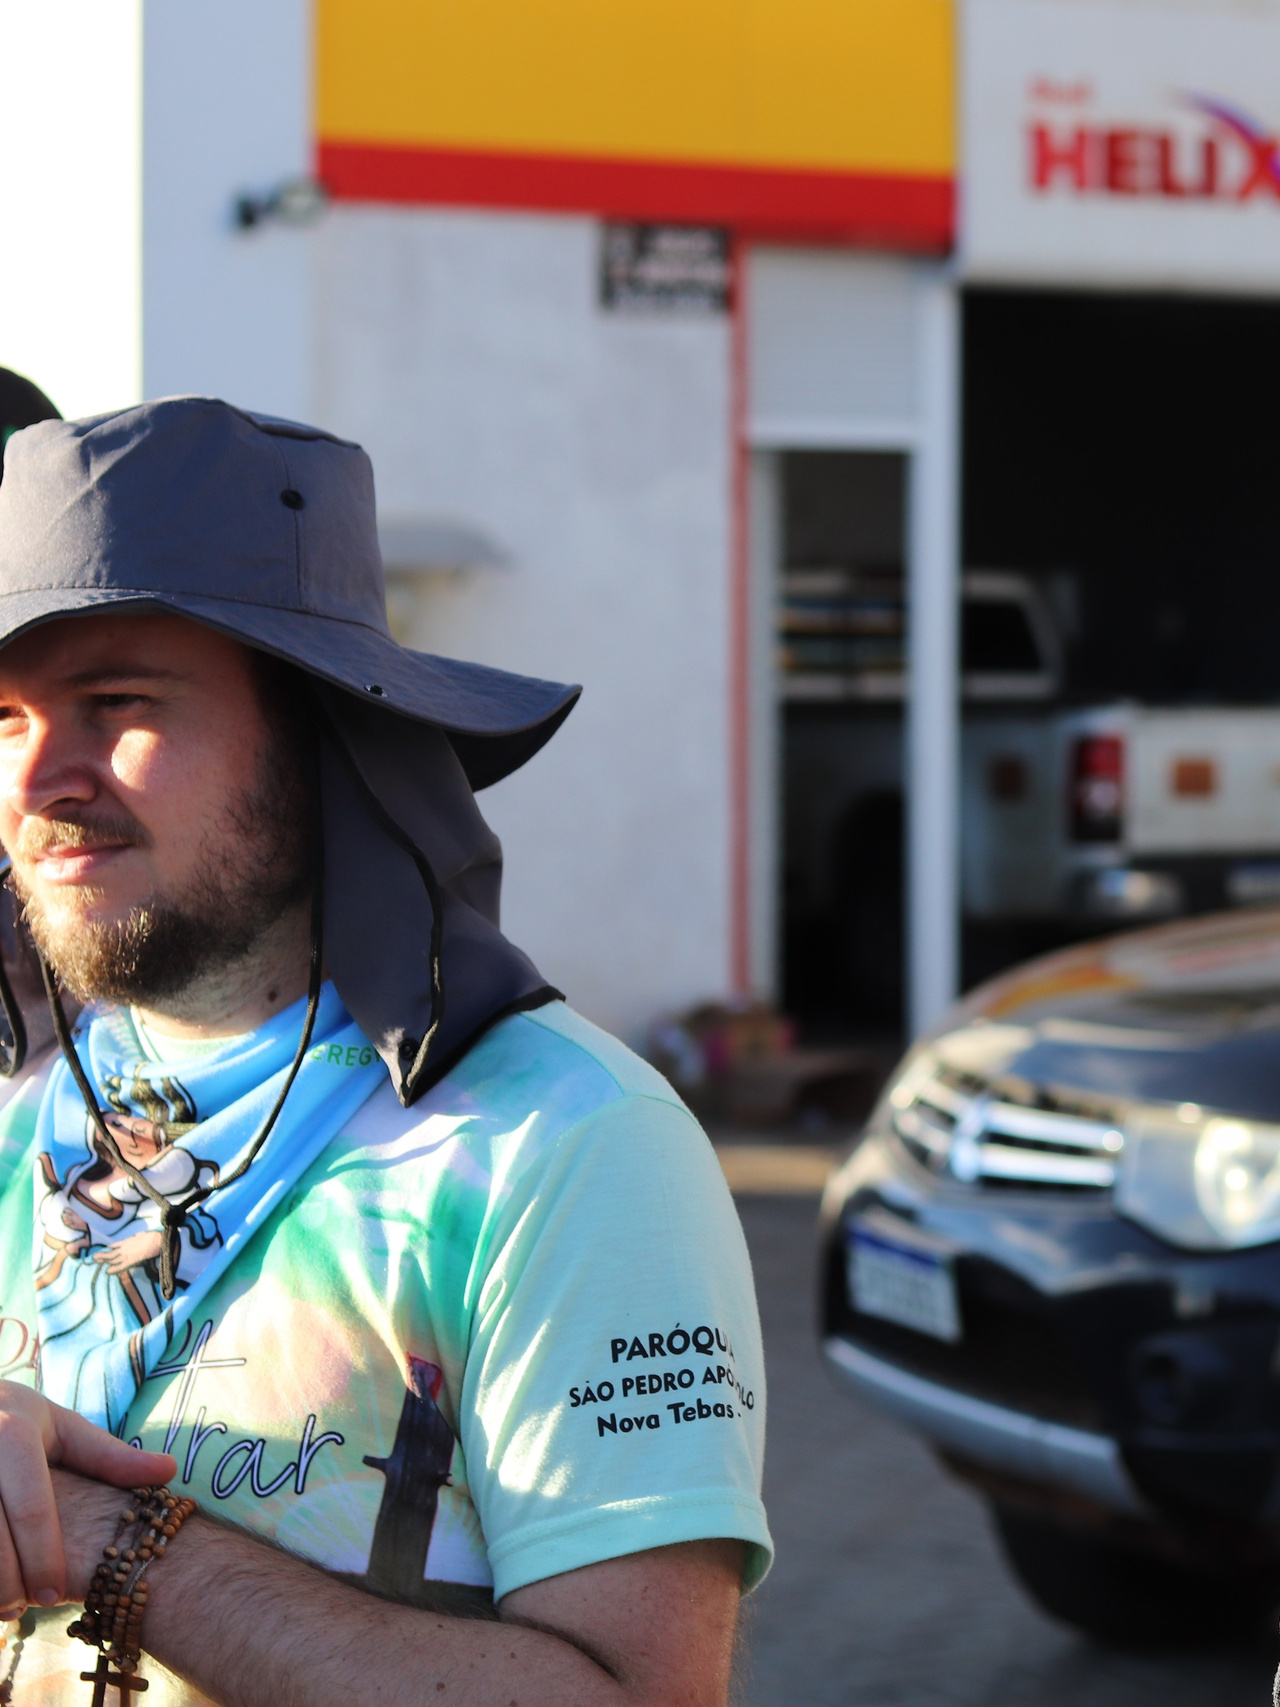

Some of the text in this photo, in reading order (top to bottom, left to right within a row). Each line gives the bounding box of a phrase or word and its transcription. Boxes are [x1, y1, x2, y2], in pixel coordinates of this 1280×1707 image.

[569, 1379, 615, 1408] SÃO
[621, 1368, 695, 1398] PEDRO
[596, 1397, 735, 1437] Nova Tebas
